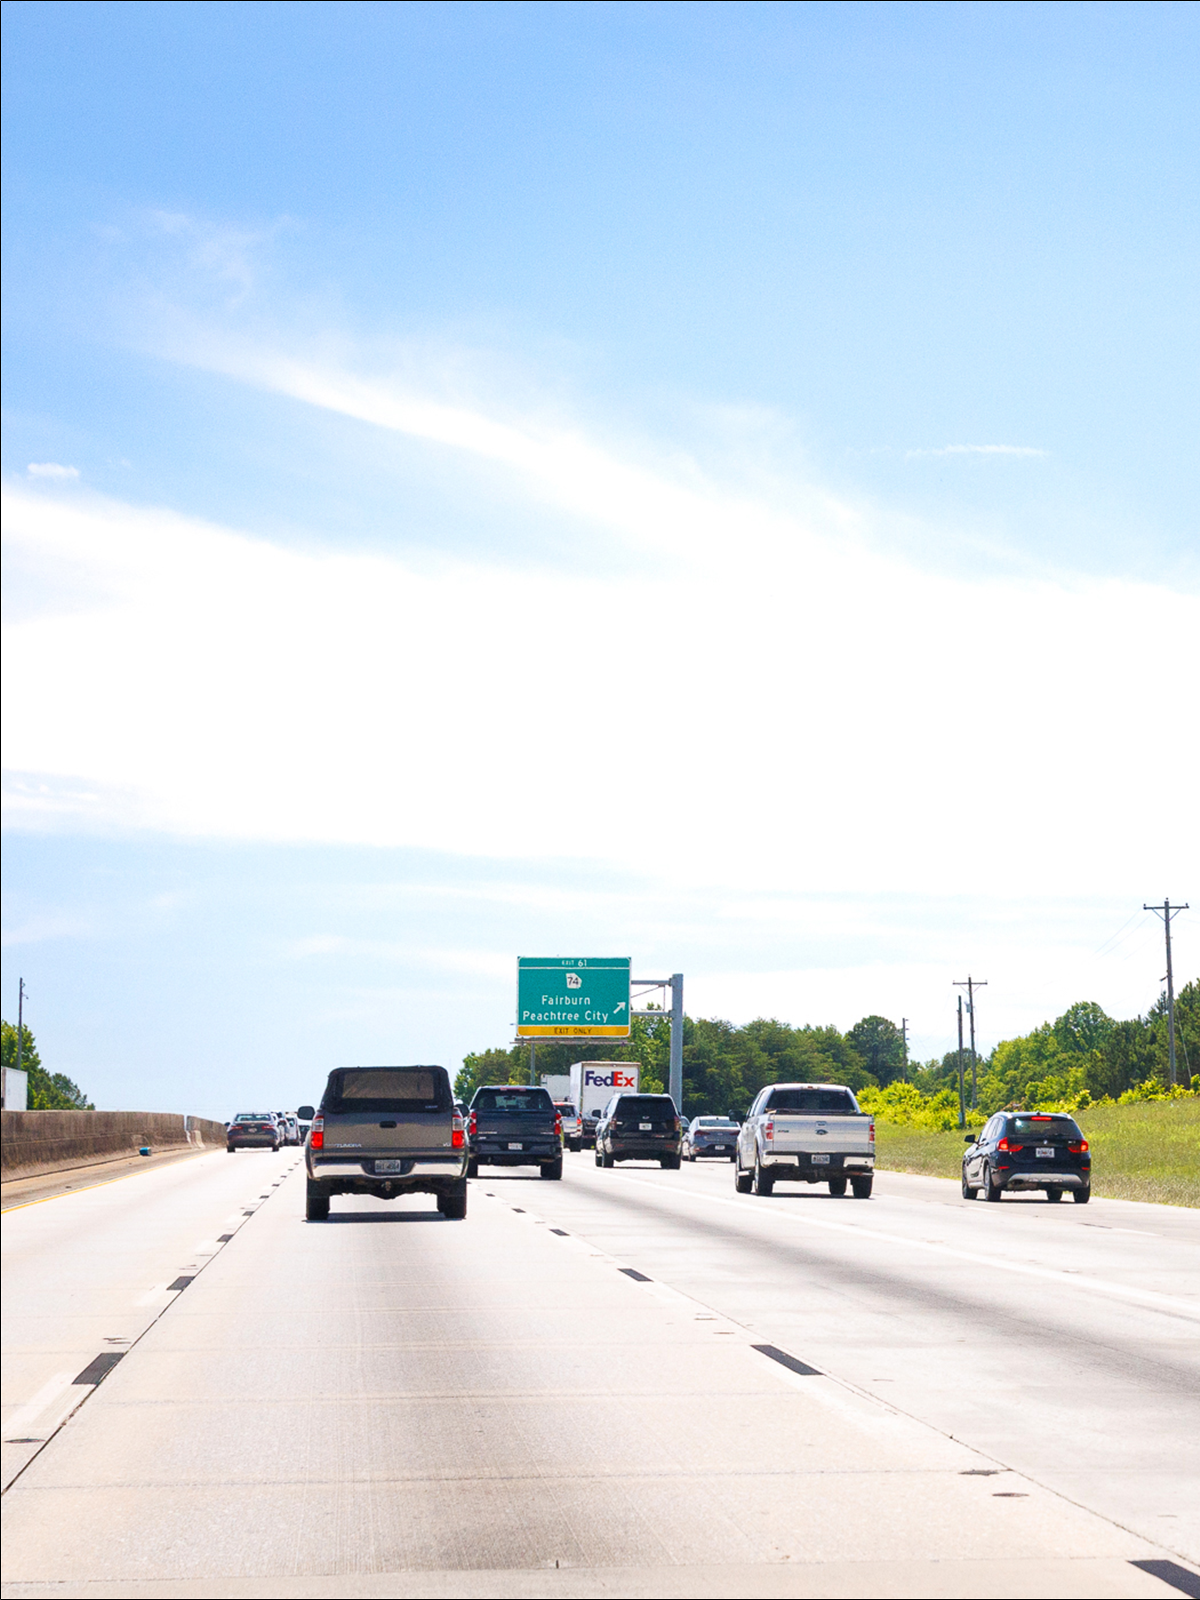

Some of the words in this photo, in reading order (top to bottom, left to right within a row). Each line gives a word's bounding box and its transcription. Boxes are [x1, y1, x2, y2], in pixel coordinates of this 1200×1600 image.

[577, 958, 587, 967] 61
[567, 976, 579, 986] 74
[541, 994, 591, 1005] Fairburn
[522, 1010, 580, 1021] Peachtree
[584, 1010, 609, 1023] City
[554, 1027, 570, 1035] EXIT
[573, 1027, 592, 1035] ONLY
[584, 1070, 635, 1087] FedEx
